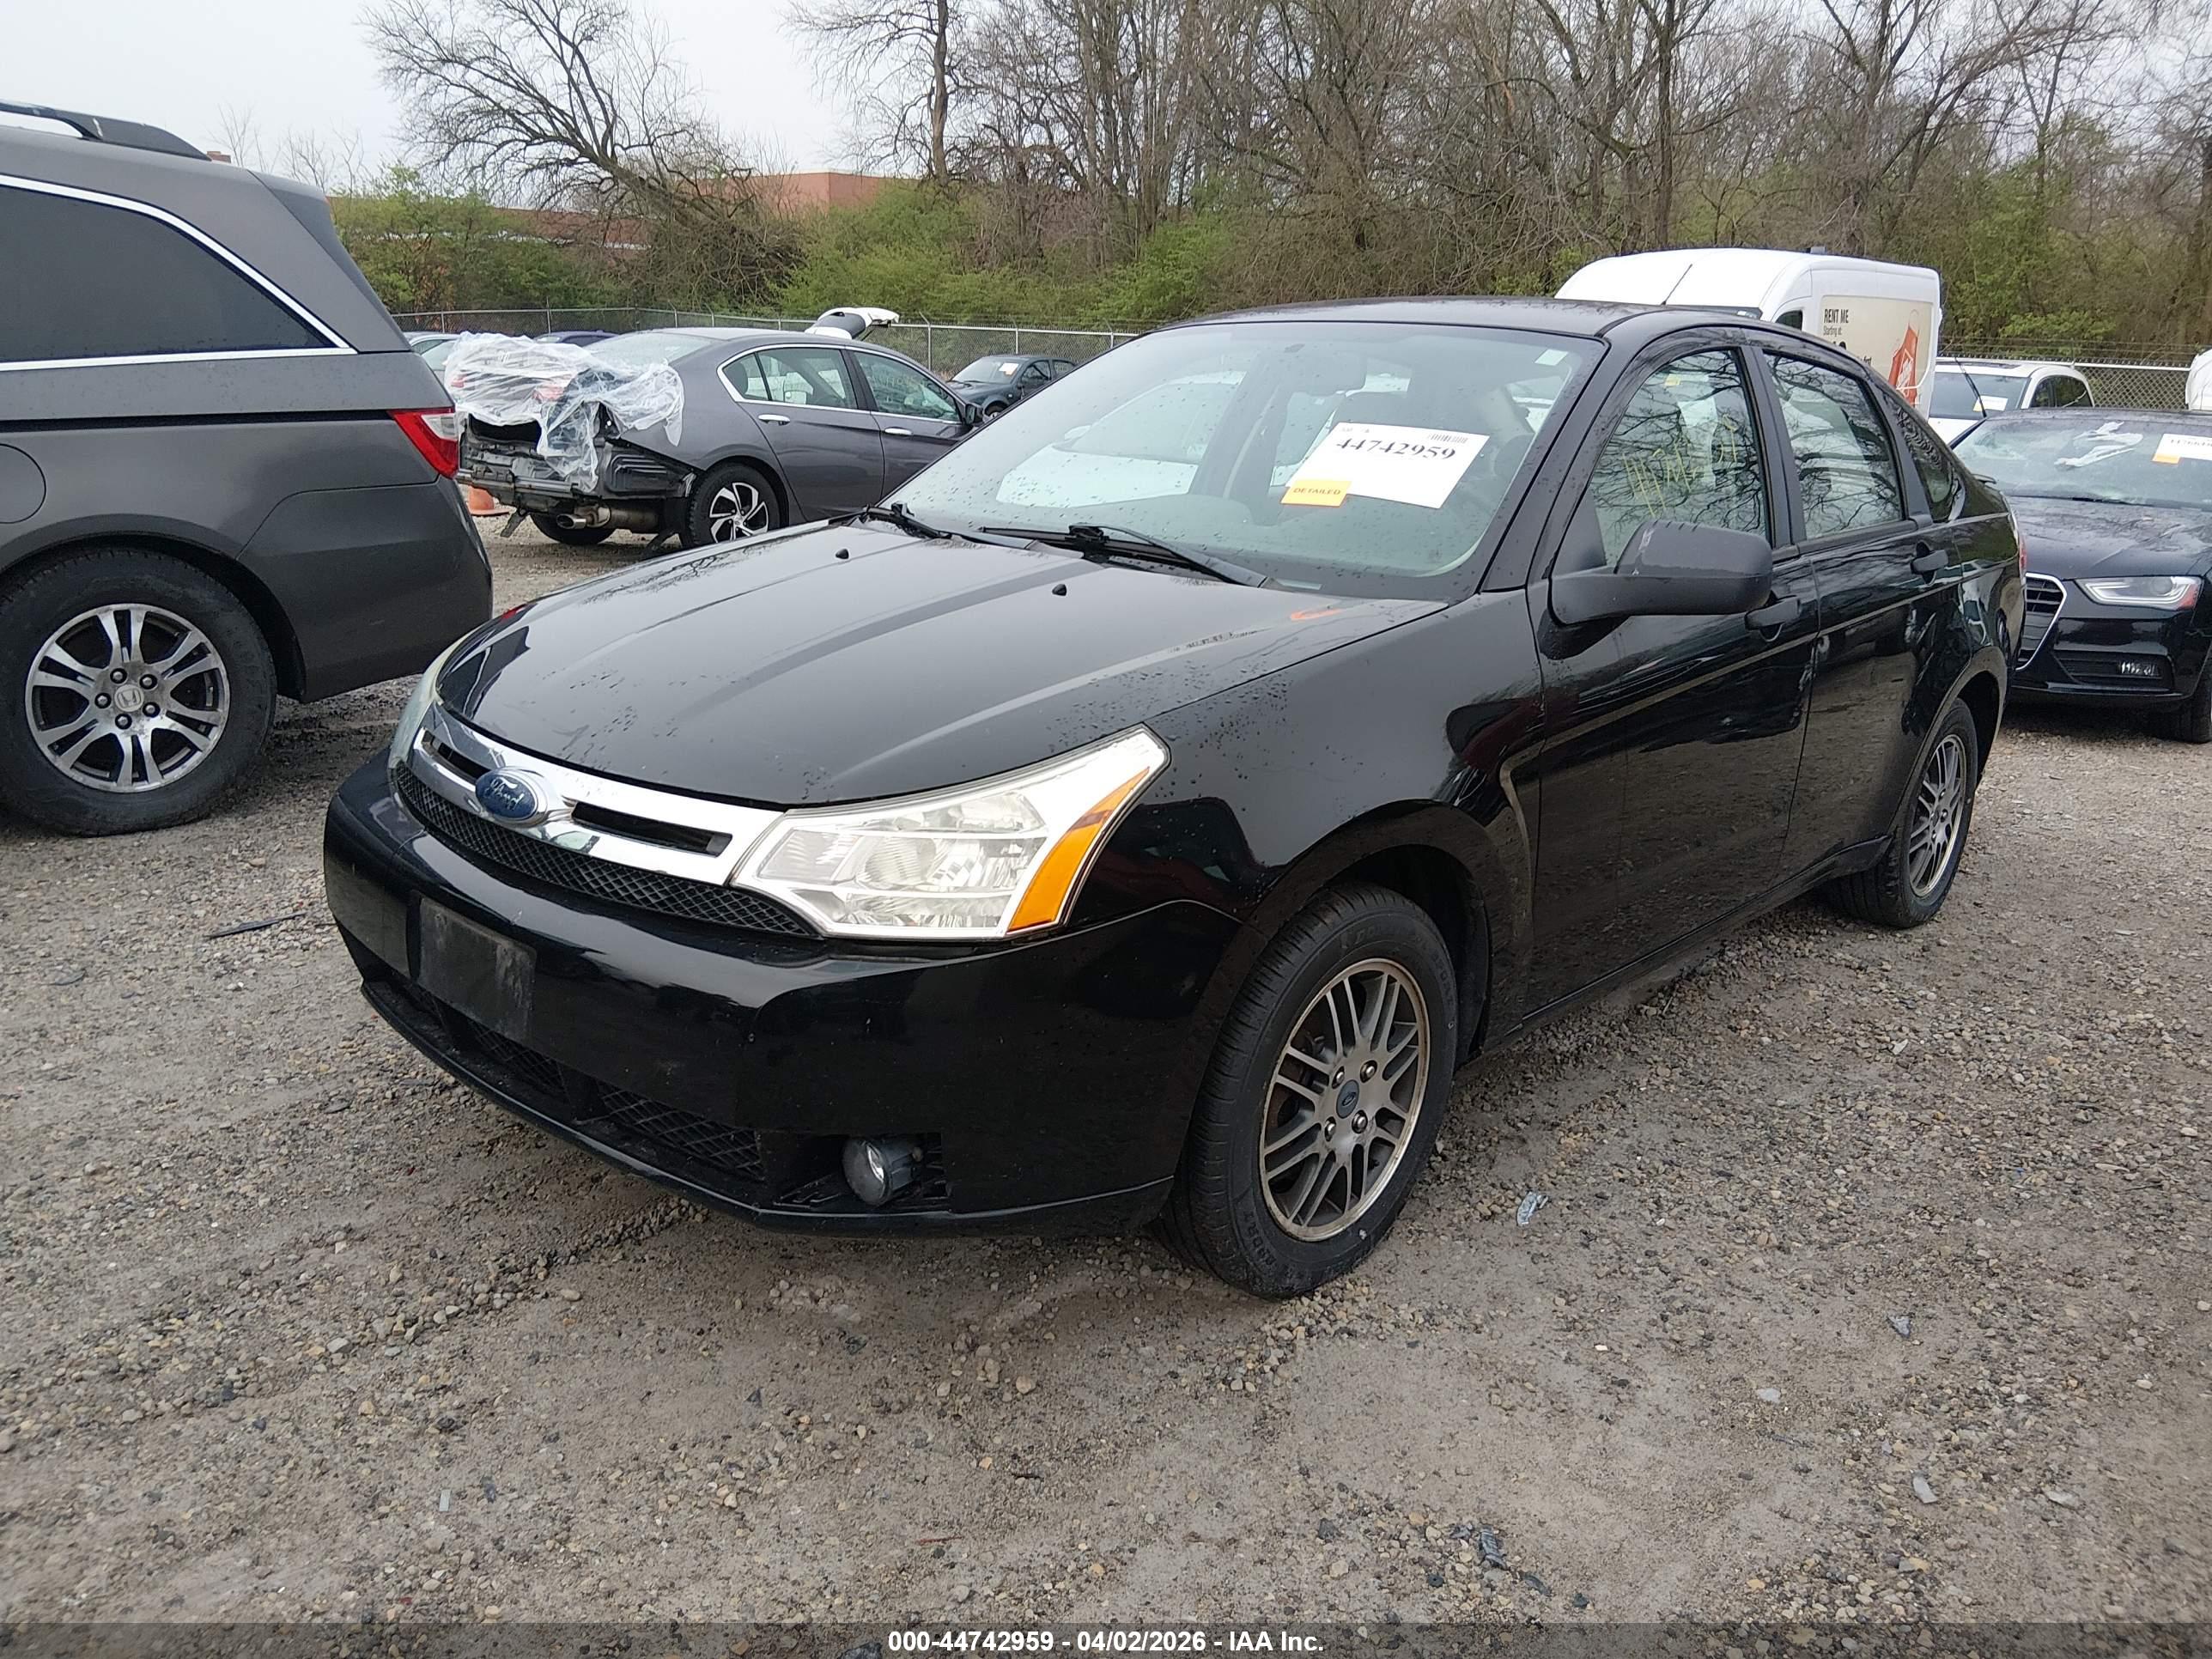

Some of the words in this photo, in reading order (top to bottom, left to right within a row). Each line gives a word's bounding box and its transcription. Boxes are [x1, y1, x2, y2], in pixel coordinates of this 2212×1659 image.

[1824, 309, 1839, 323] RENT
[1840, 309, 1849, 324] ME
[1823, 325, 1838, 337] Starting
[1336, 437, 1456, 459] 44742959
[1292, 487, 1341, 495] DETAILED
[483, 775, 526, 811] Ford
